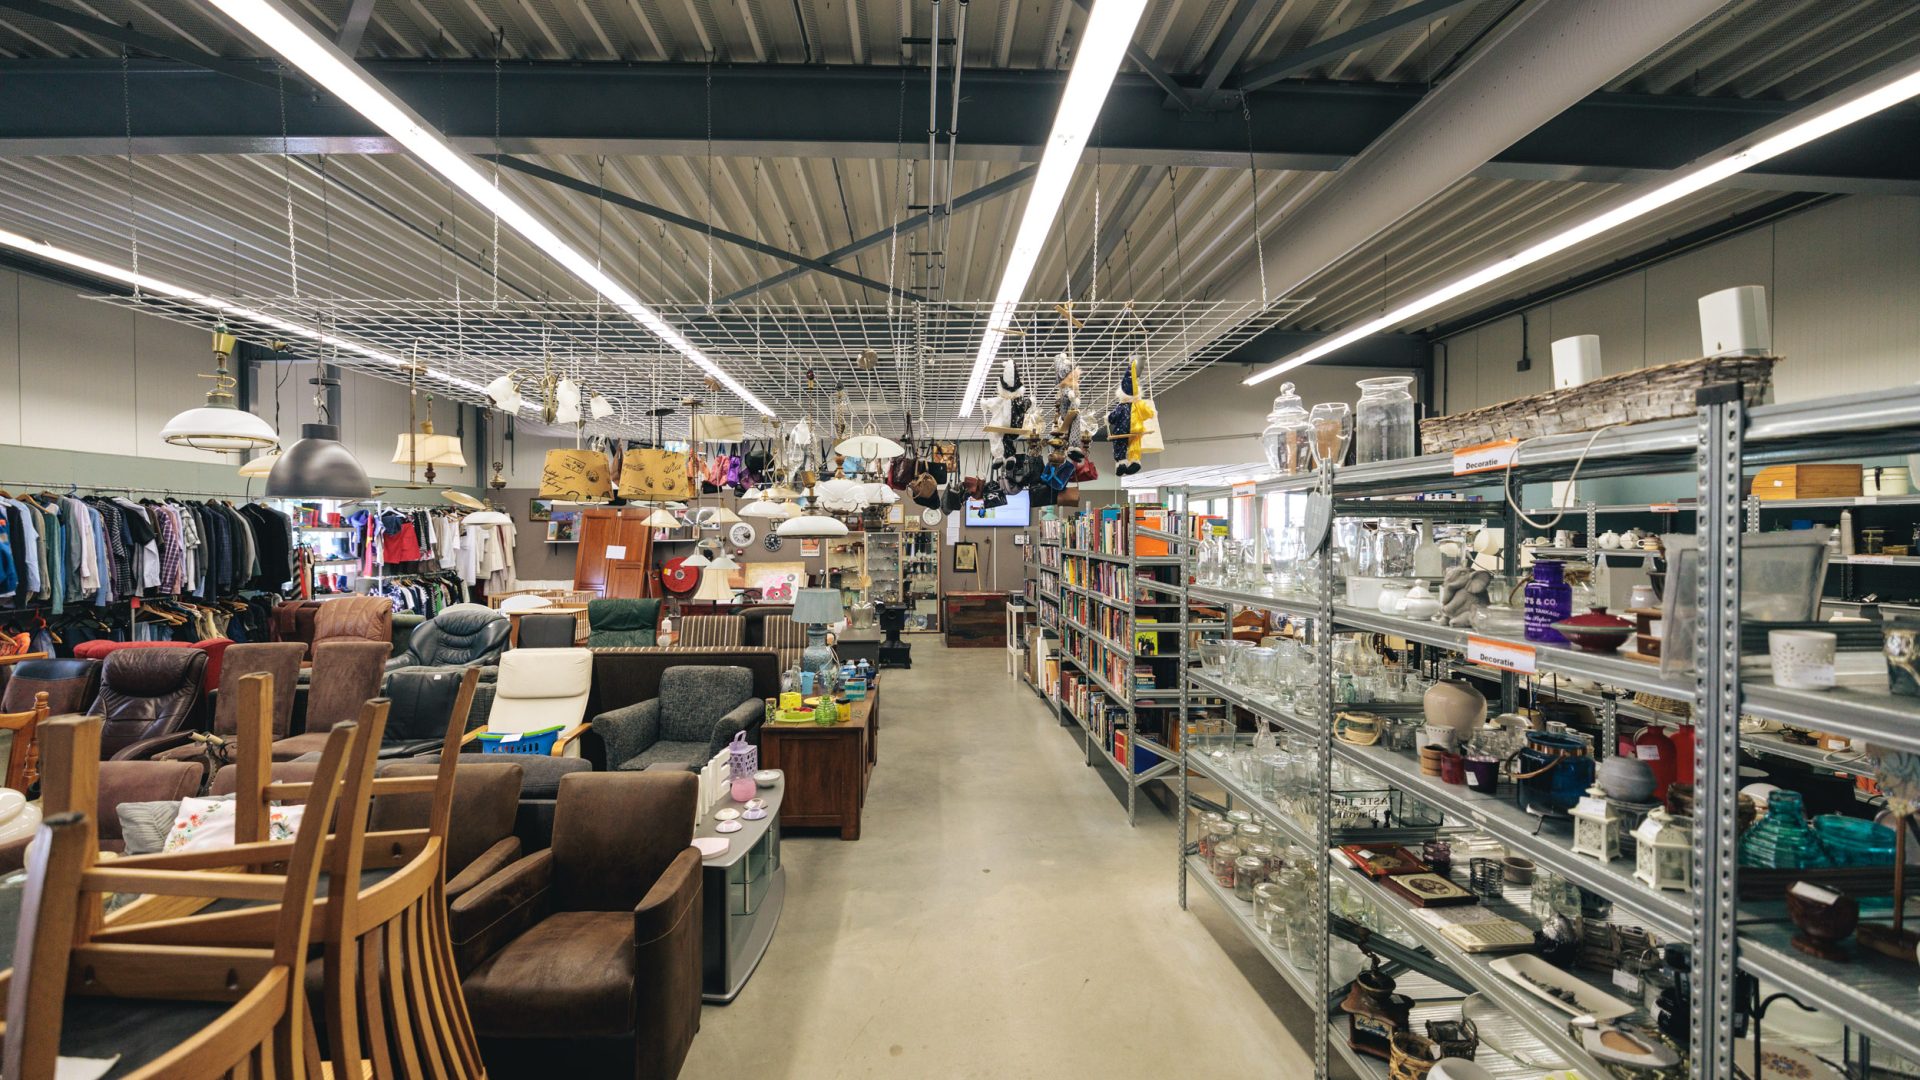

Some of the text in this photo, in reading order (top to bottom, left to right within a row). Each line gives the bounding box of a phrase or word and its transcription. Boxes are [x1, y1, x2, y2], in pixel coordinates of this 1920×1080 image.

[1466, 458, 1498, 470] Decoratie
[1535, 597, 1542, 606] &
[1480, 653, 1514, 667] Decoratie
